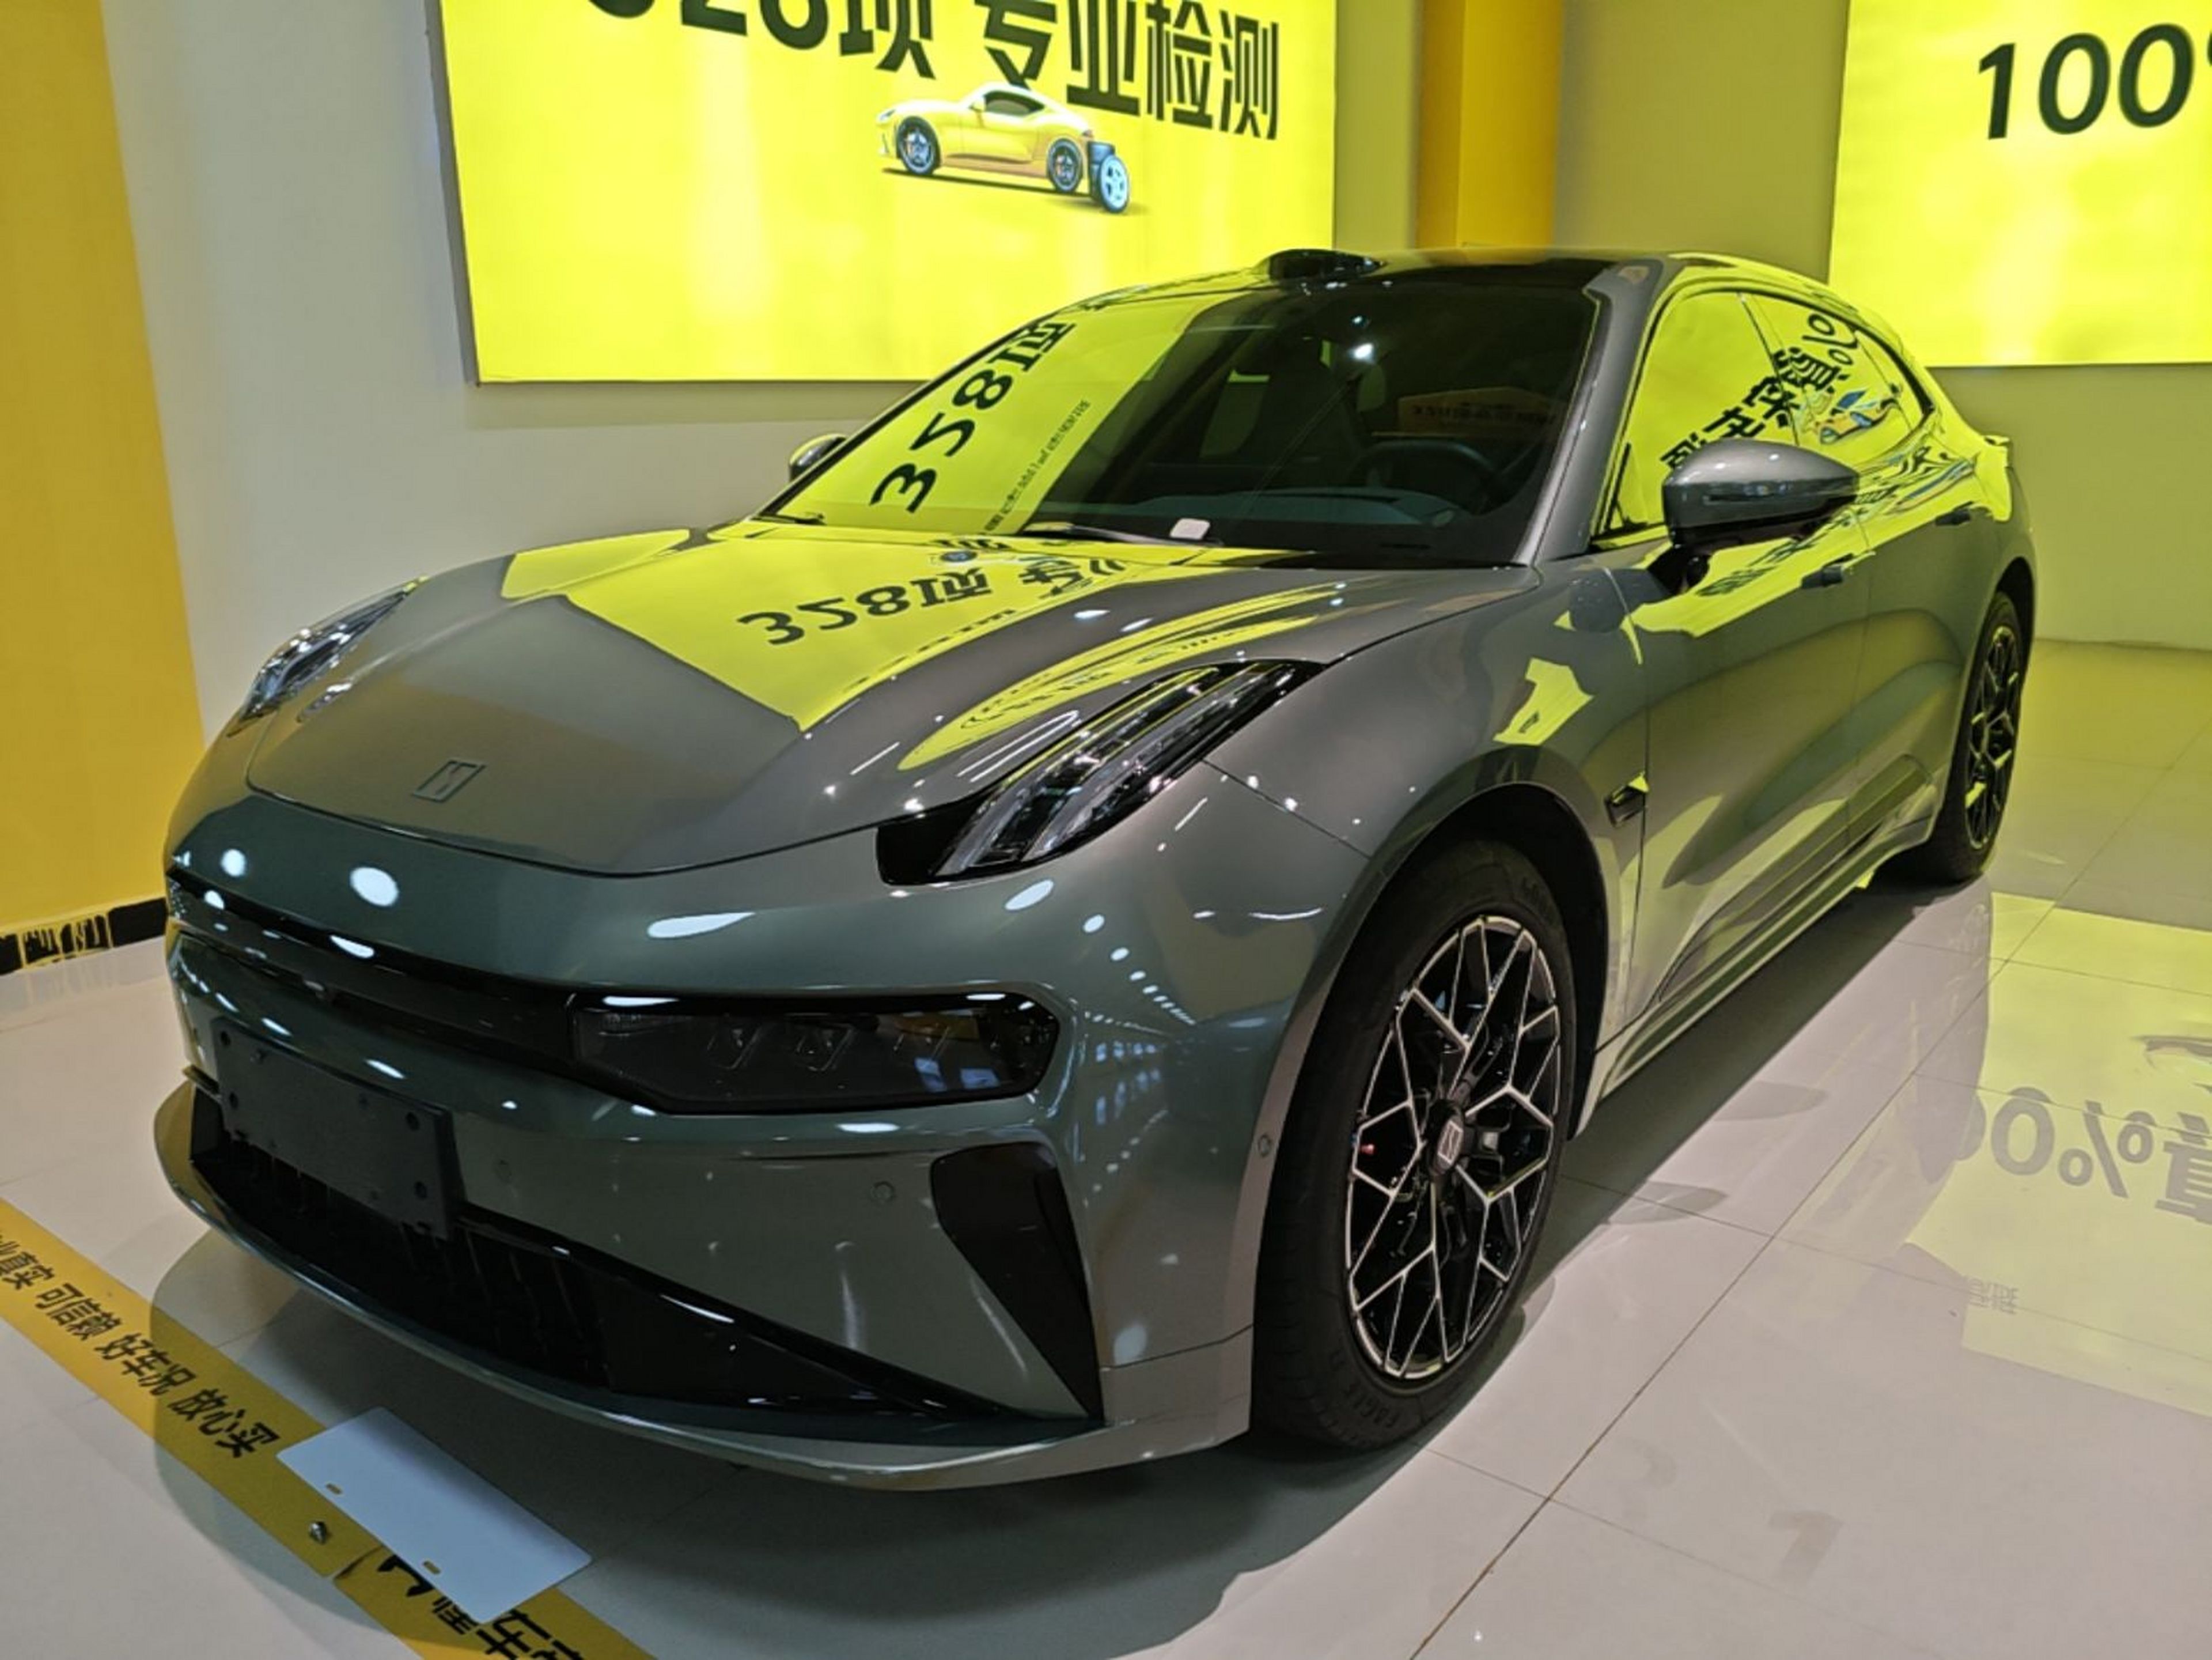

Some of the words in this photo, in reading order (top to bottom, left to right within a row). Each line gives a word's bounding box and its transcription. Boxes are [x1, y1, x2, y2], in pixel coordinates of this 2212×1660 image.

[975, 0, 1280, 141] 专业检测
[1979, 24, 2212, 140] 100
[35, 1283, 122, 1341] 可信赖
[94, 1332, 196, 1396] 好车况
[168, 1388, 280, 1458] 放心买
